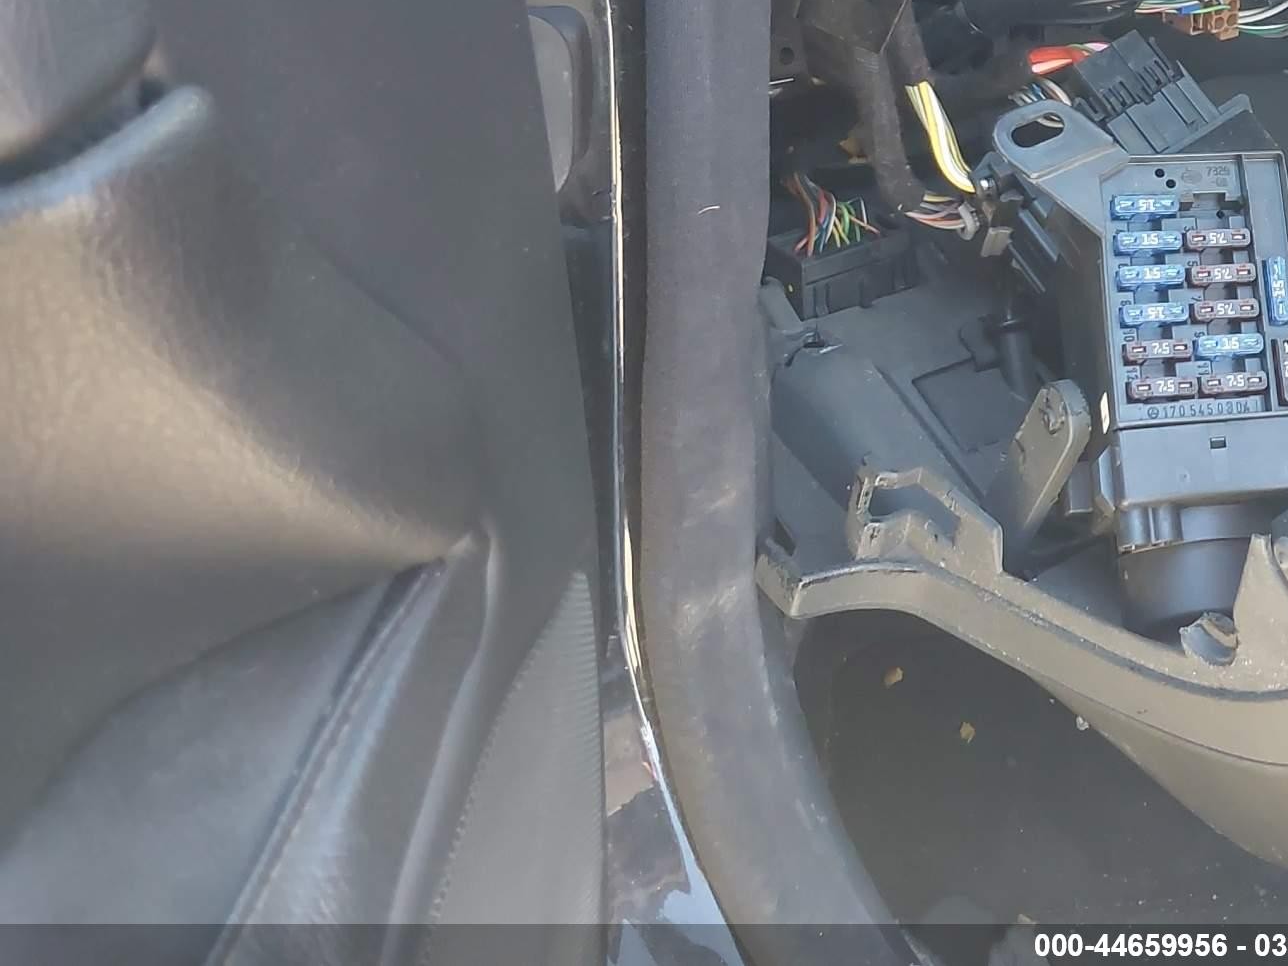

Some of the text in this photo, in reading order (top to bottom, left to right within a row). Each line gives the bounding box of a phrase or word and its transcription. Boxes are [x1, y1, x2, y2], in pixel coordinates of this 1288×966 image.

[1141, 233, 1159, 245] 15
[1208, 232, 1228, 244] 7.5
[1143, 267, 1161, 279] 15
[1214, 267, 1233, 280] 7.5
[1216, 302, 1236, 315] 7.5
[1151, 342, 1170, 355] 7.5
[1220, 337, 1240, 350] 15
[1155, 379, 1175, 393] 7.5
[1226, 374, 1246, 388] 7.5
